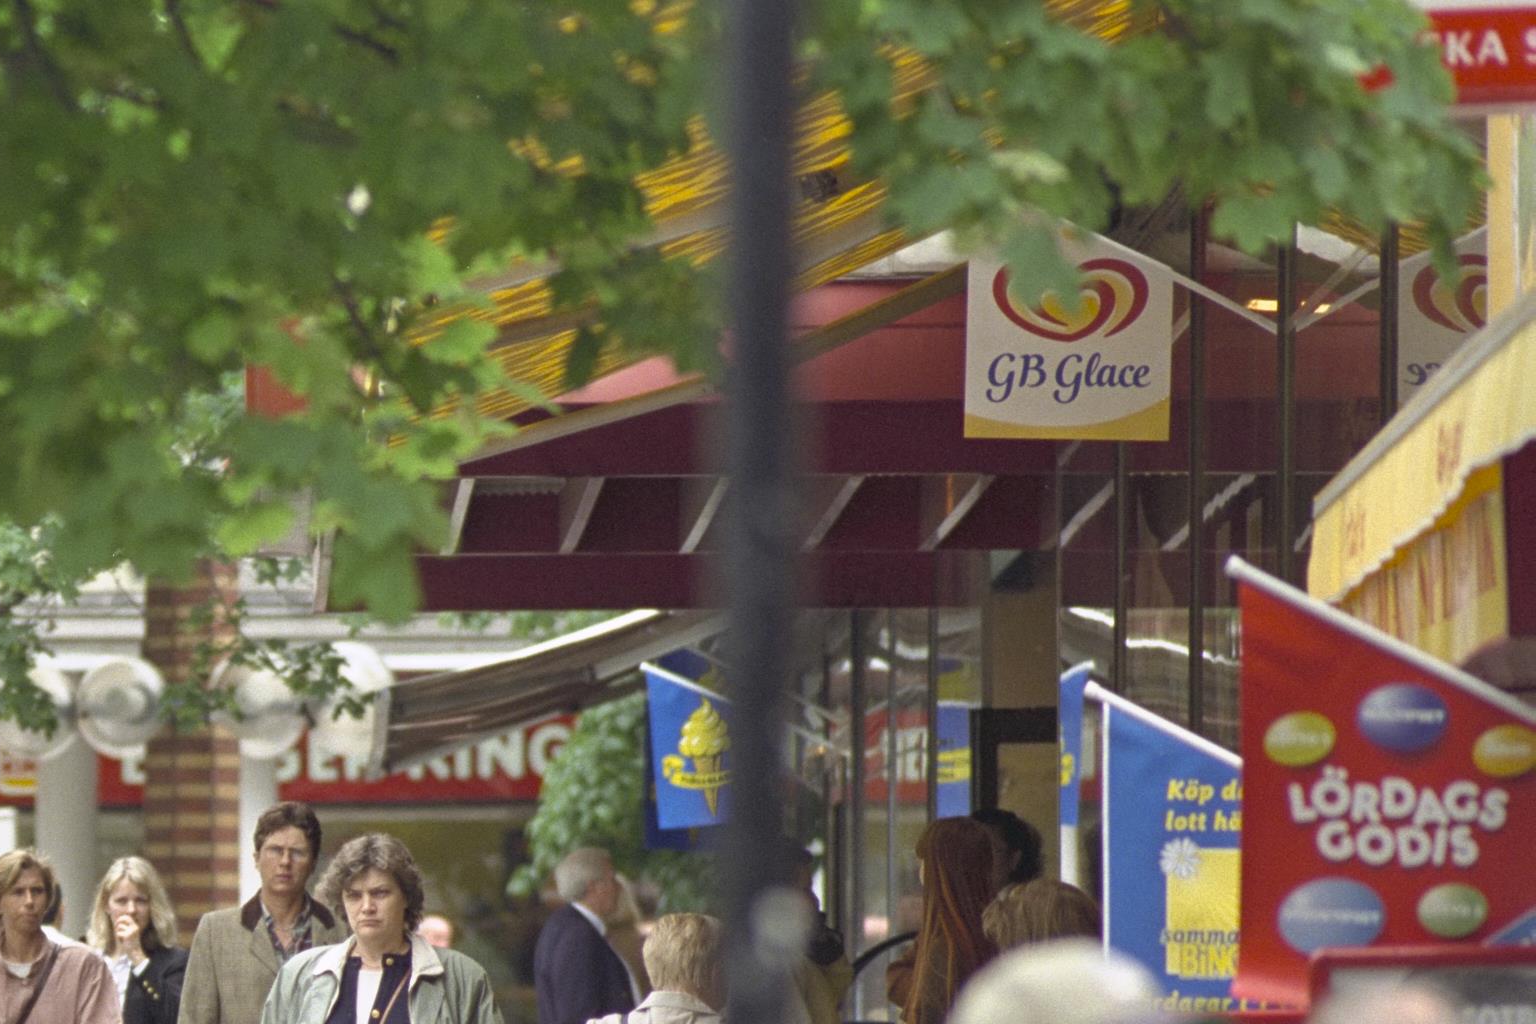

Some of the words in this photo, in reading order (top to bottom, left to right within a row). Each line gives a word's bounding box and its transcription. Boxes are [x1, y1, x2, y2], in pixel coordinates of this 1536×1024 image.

[986, 352, 1047, 403] GB
[1053, 352, 1151, 404] Glace
[1167, 778, 1215, 806] Köp
[1287, 764, 1510, 832] LÖRDAGS
[1165, 809, 1206, 833] lott
[1214, 809, 1243, 833] hä
[1317, 819, 1480, 868] GODIS
